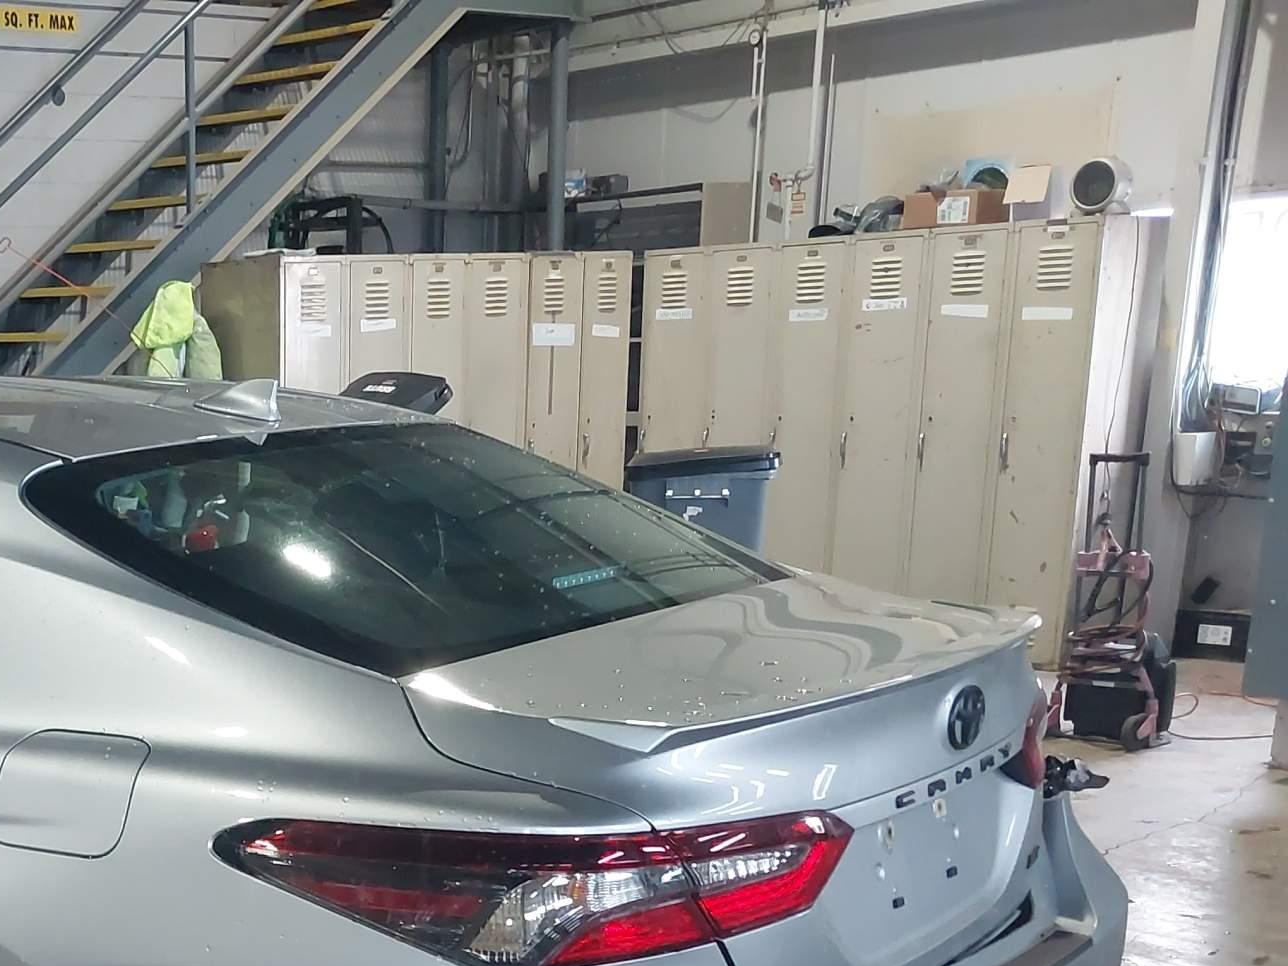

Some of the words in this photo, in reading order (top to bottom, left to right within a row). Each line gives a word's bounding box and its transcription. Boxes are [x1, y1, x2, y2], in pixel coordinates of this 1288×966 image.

[4, 11, 23, 28] SQ.
[28, 13, 44, 29] FT.
[49, 14, 75, 31] MAX
[895, 742, 1011, 809] CAMRY
